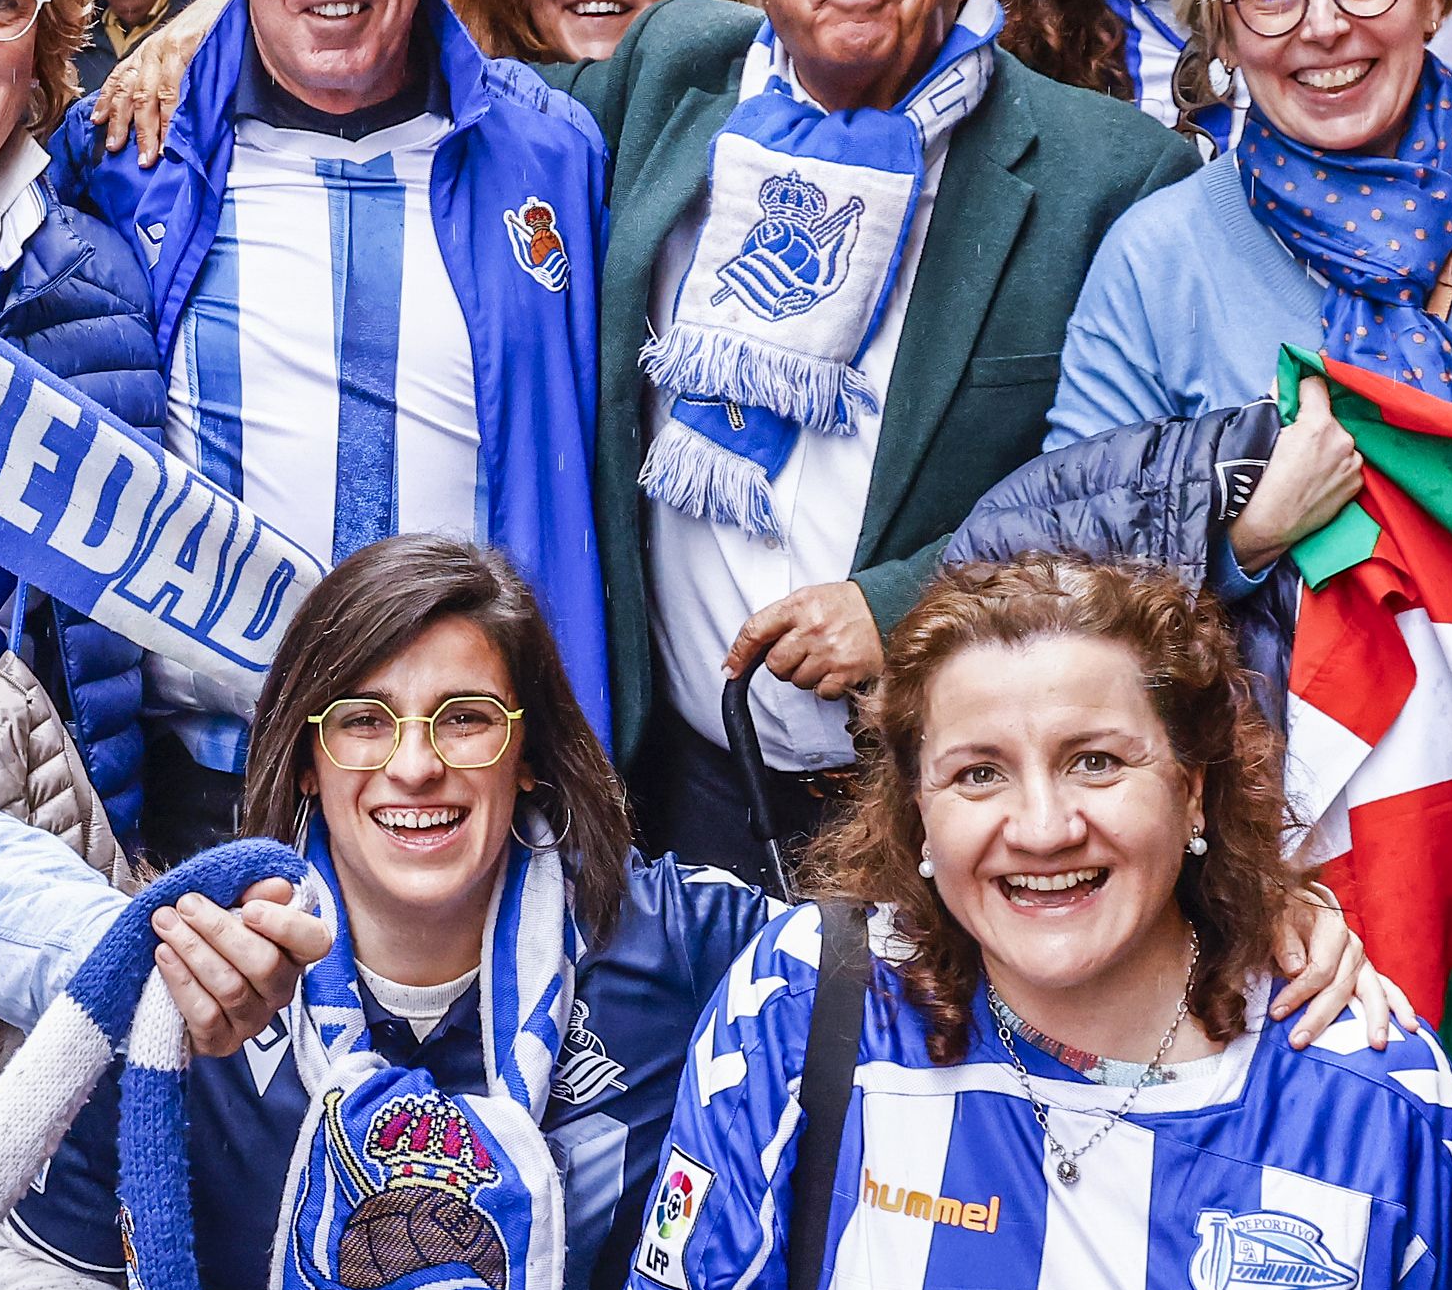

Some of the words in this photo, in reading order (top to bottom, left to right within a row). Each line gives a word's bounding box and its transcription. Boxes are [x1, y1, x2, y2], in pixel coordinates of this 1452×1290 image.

[862, 1166, 1001, 1235] hummel
[1235, 1218, 1315, 1242] DEPORTIVO
[645, 1243, 670, 1277] LFP
